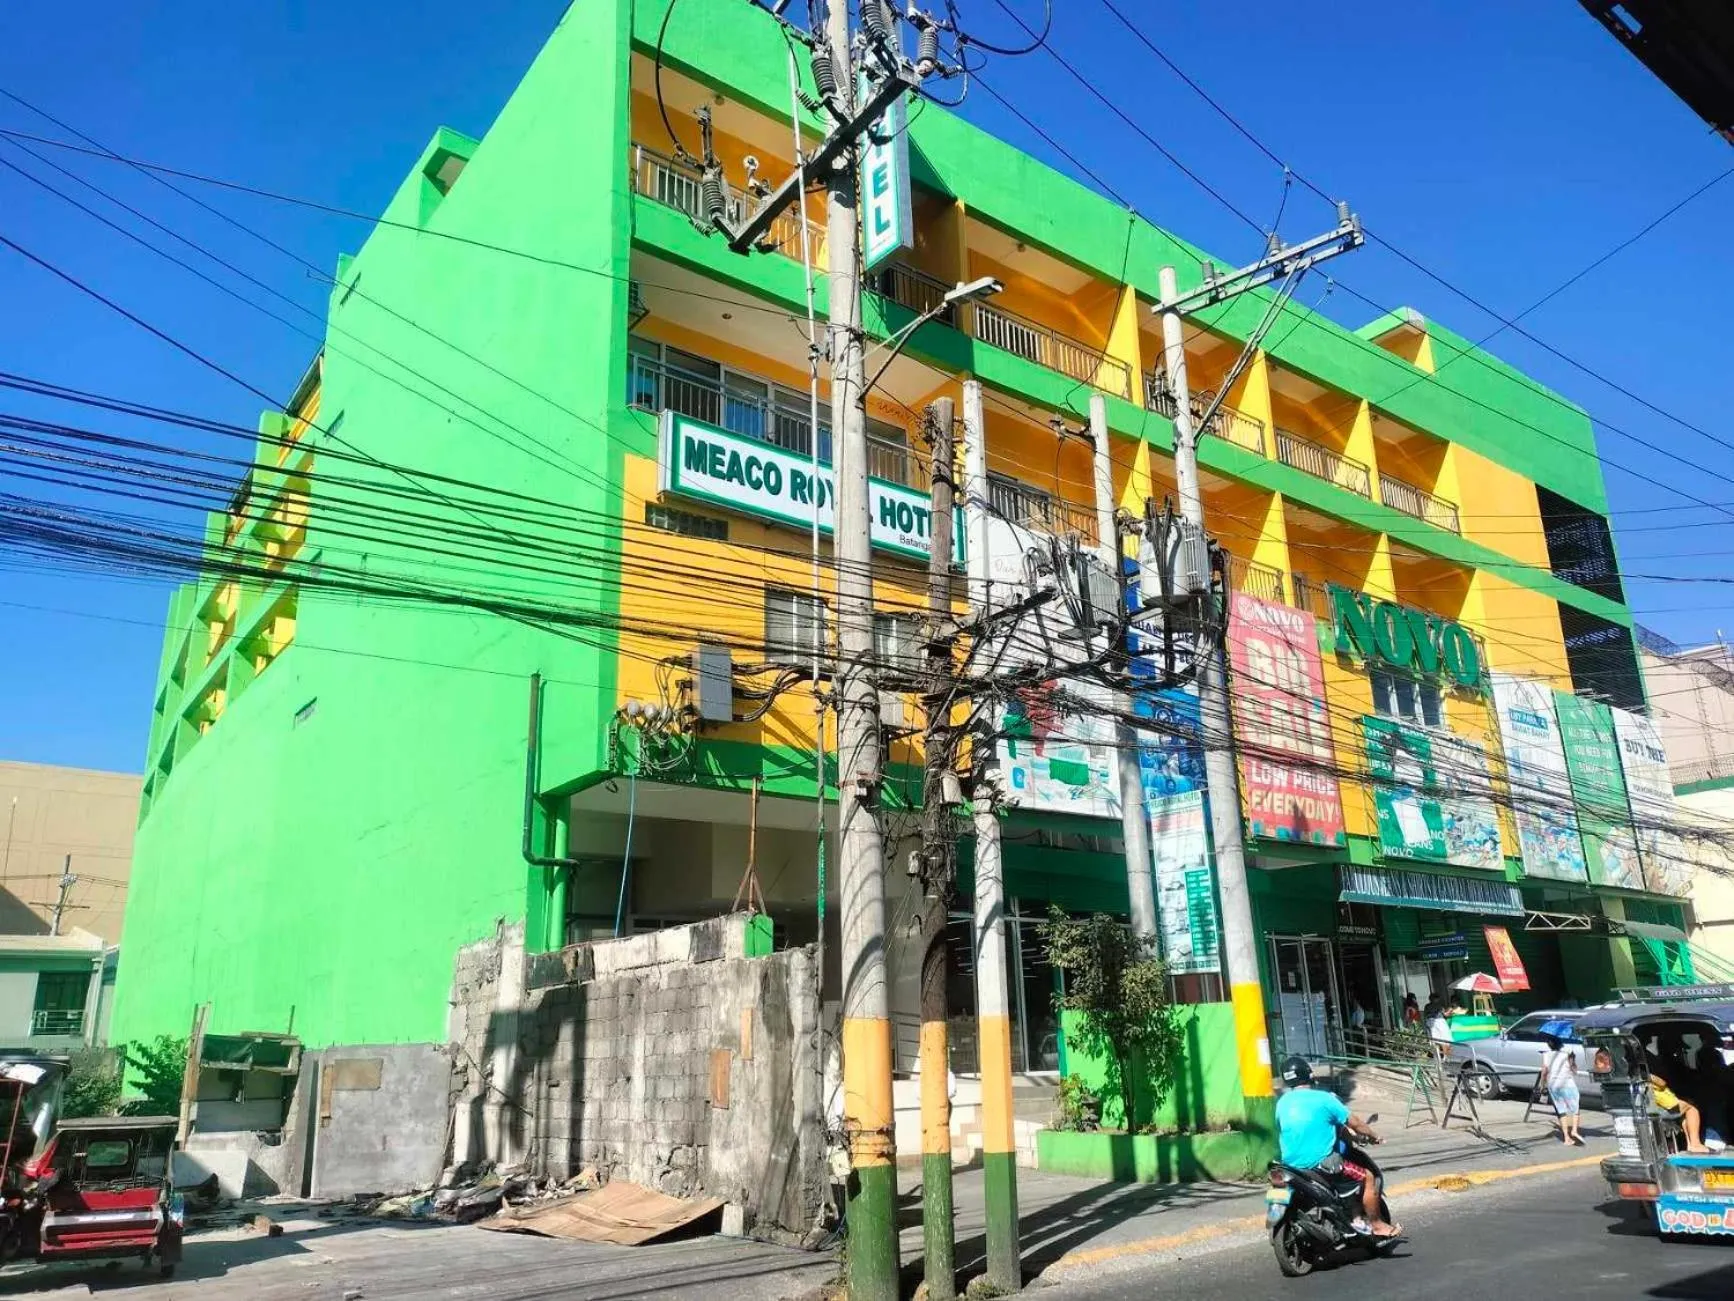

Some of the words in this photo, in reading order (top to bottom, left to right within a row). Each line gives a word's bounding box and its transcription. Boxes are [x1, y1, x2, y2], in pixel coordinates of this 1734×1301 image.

[684, 435, 783, 496] MEACO
[1329, 587, 1480, 688] NOVO
[1250, 760, 1289, 787] LOW
[1250, 789, 1341, 824] EVERYDAY!
[1383, 845, 1414, 858] NOVO
[1662, 1209, 1706, 1229] GOD
